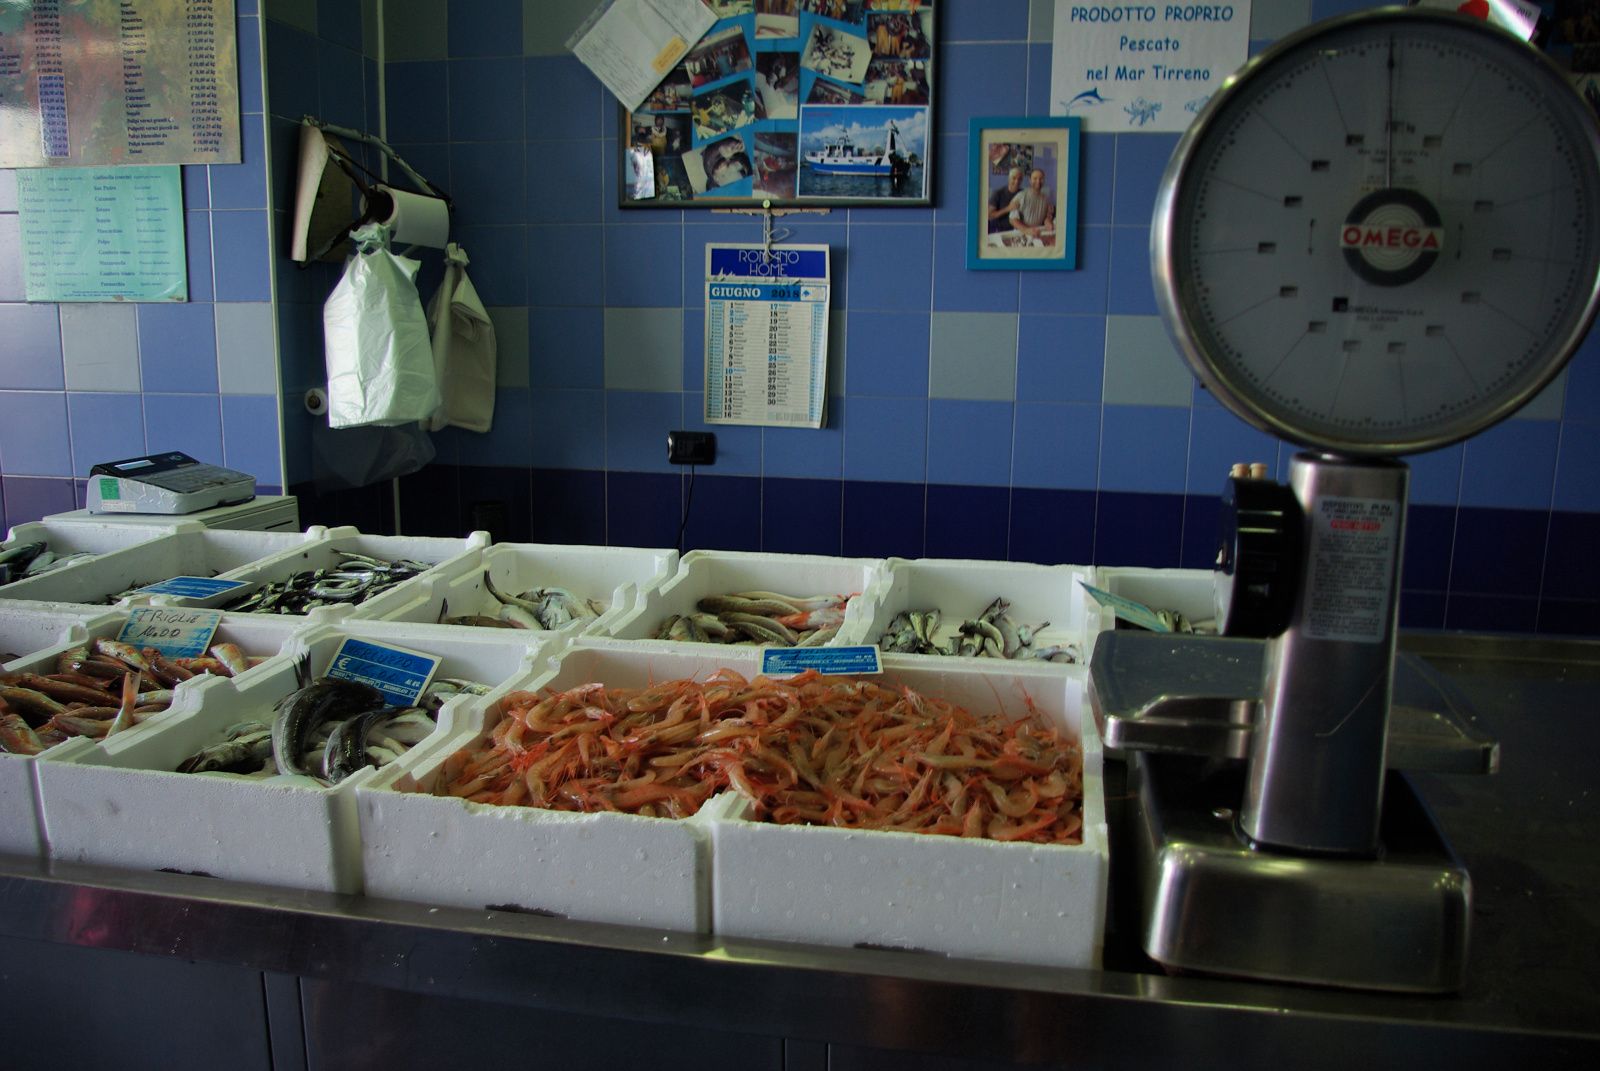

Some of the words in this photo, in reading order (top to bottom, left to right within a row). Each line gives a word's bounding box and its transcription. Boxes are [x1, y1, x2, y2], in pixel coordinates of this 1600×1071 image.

[1071, 6, 1156, 22] PRODOTTO
[1165, 6, 1233, 22] PROPRIO
[1120, 36, 1179, 51] Pescato
[1087, 65, 1108, 81] nel
[1115, 65, 1145, 81] Mar
[1153, 65, 1210, 81] Tirreno
[1344, 226, 1439, 248] OMEGA
[749, 263, 788, 276] HOME
[711, 287, 761, 298] GIUGNO
[771, 288, 800, 298] 2018
[338, 657, 351, 670] €
